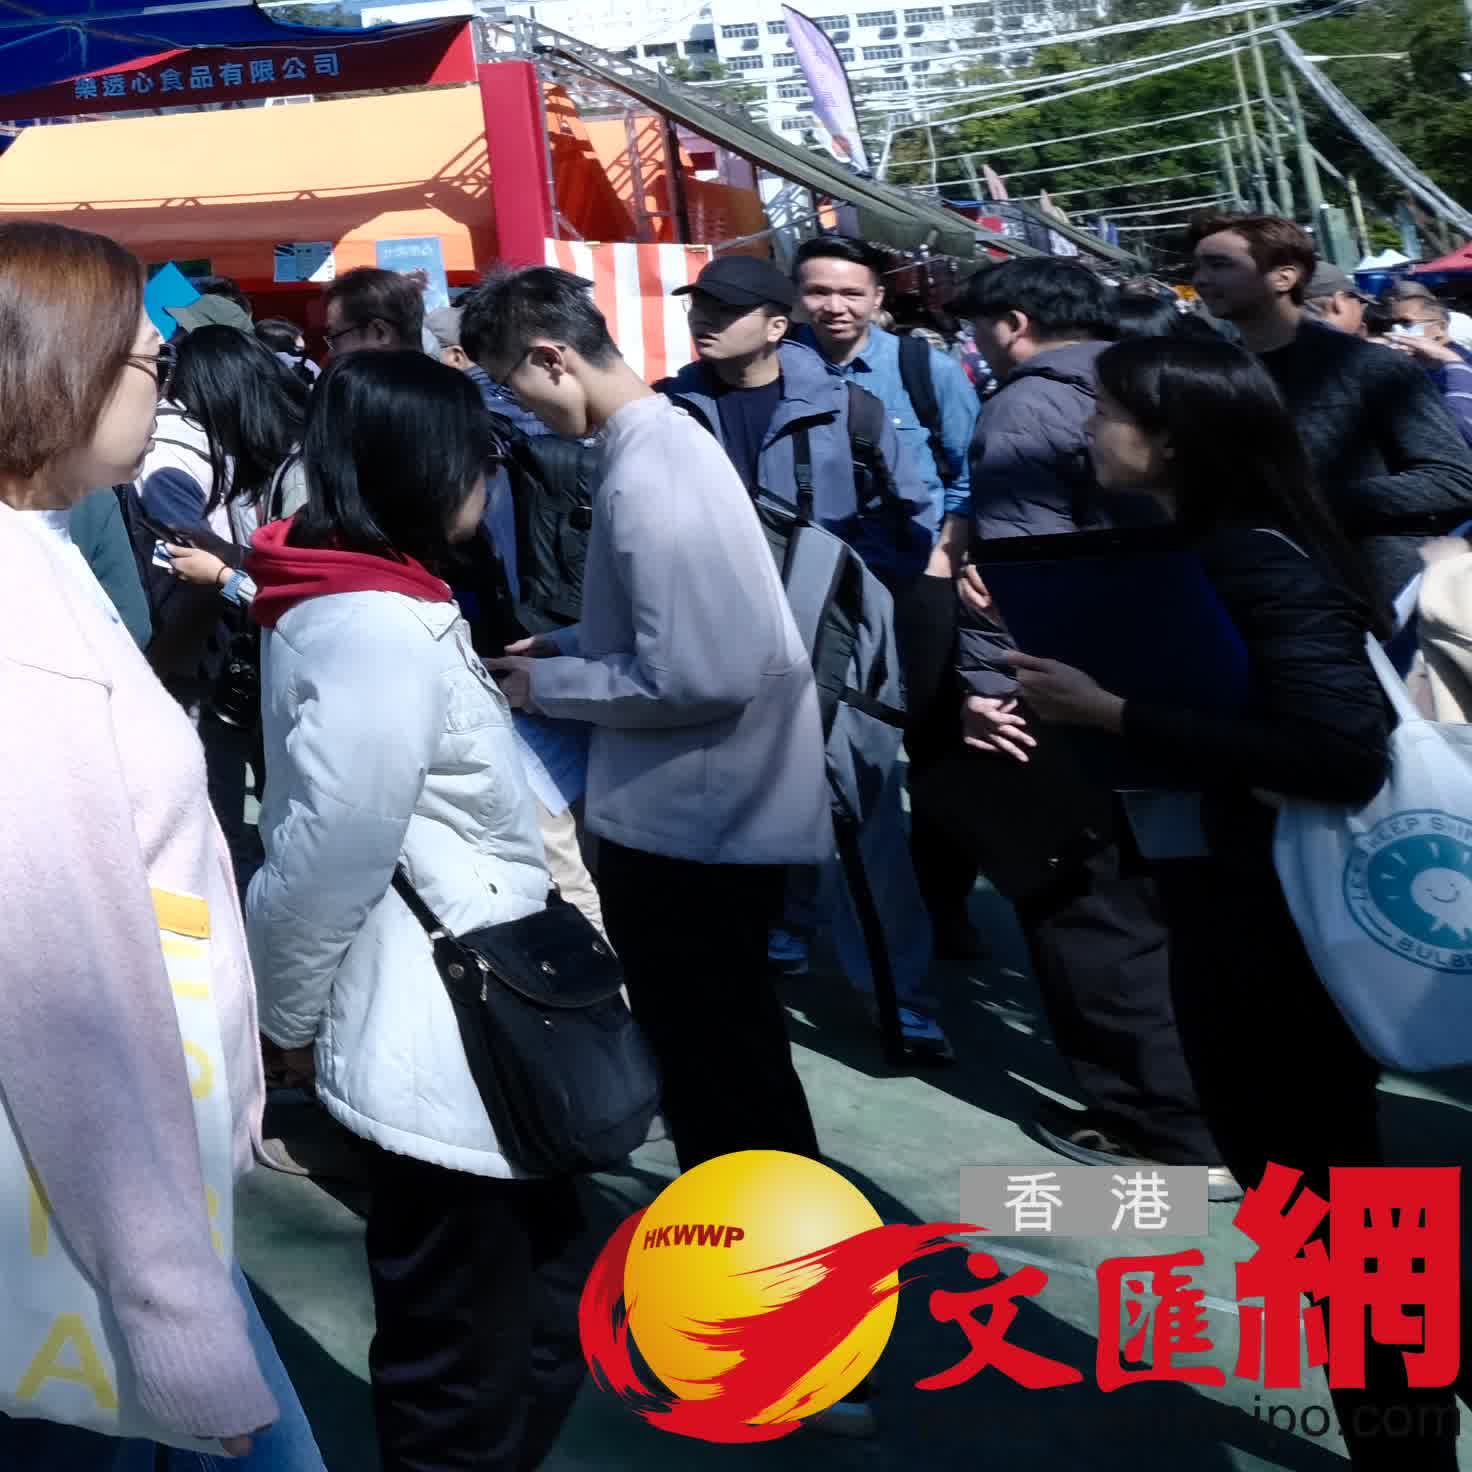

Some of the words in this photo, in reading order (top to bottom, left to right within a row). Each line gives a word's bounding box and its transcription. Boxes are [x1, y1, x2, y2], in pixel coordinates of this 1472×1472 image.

[74, 52, 340, 100] 樂透心食品有限公司
[14, 1310, 121, 1411] A
